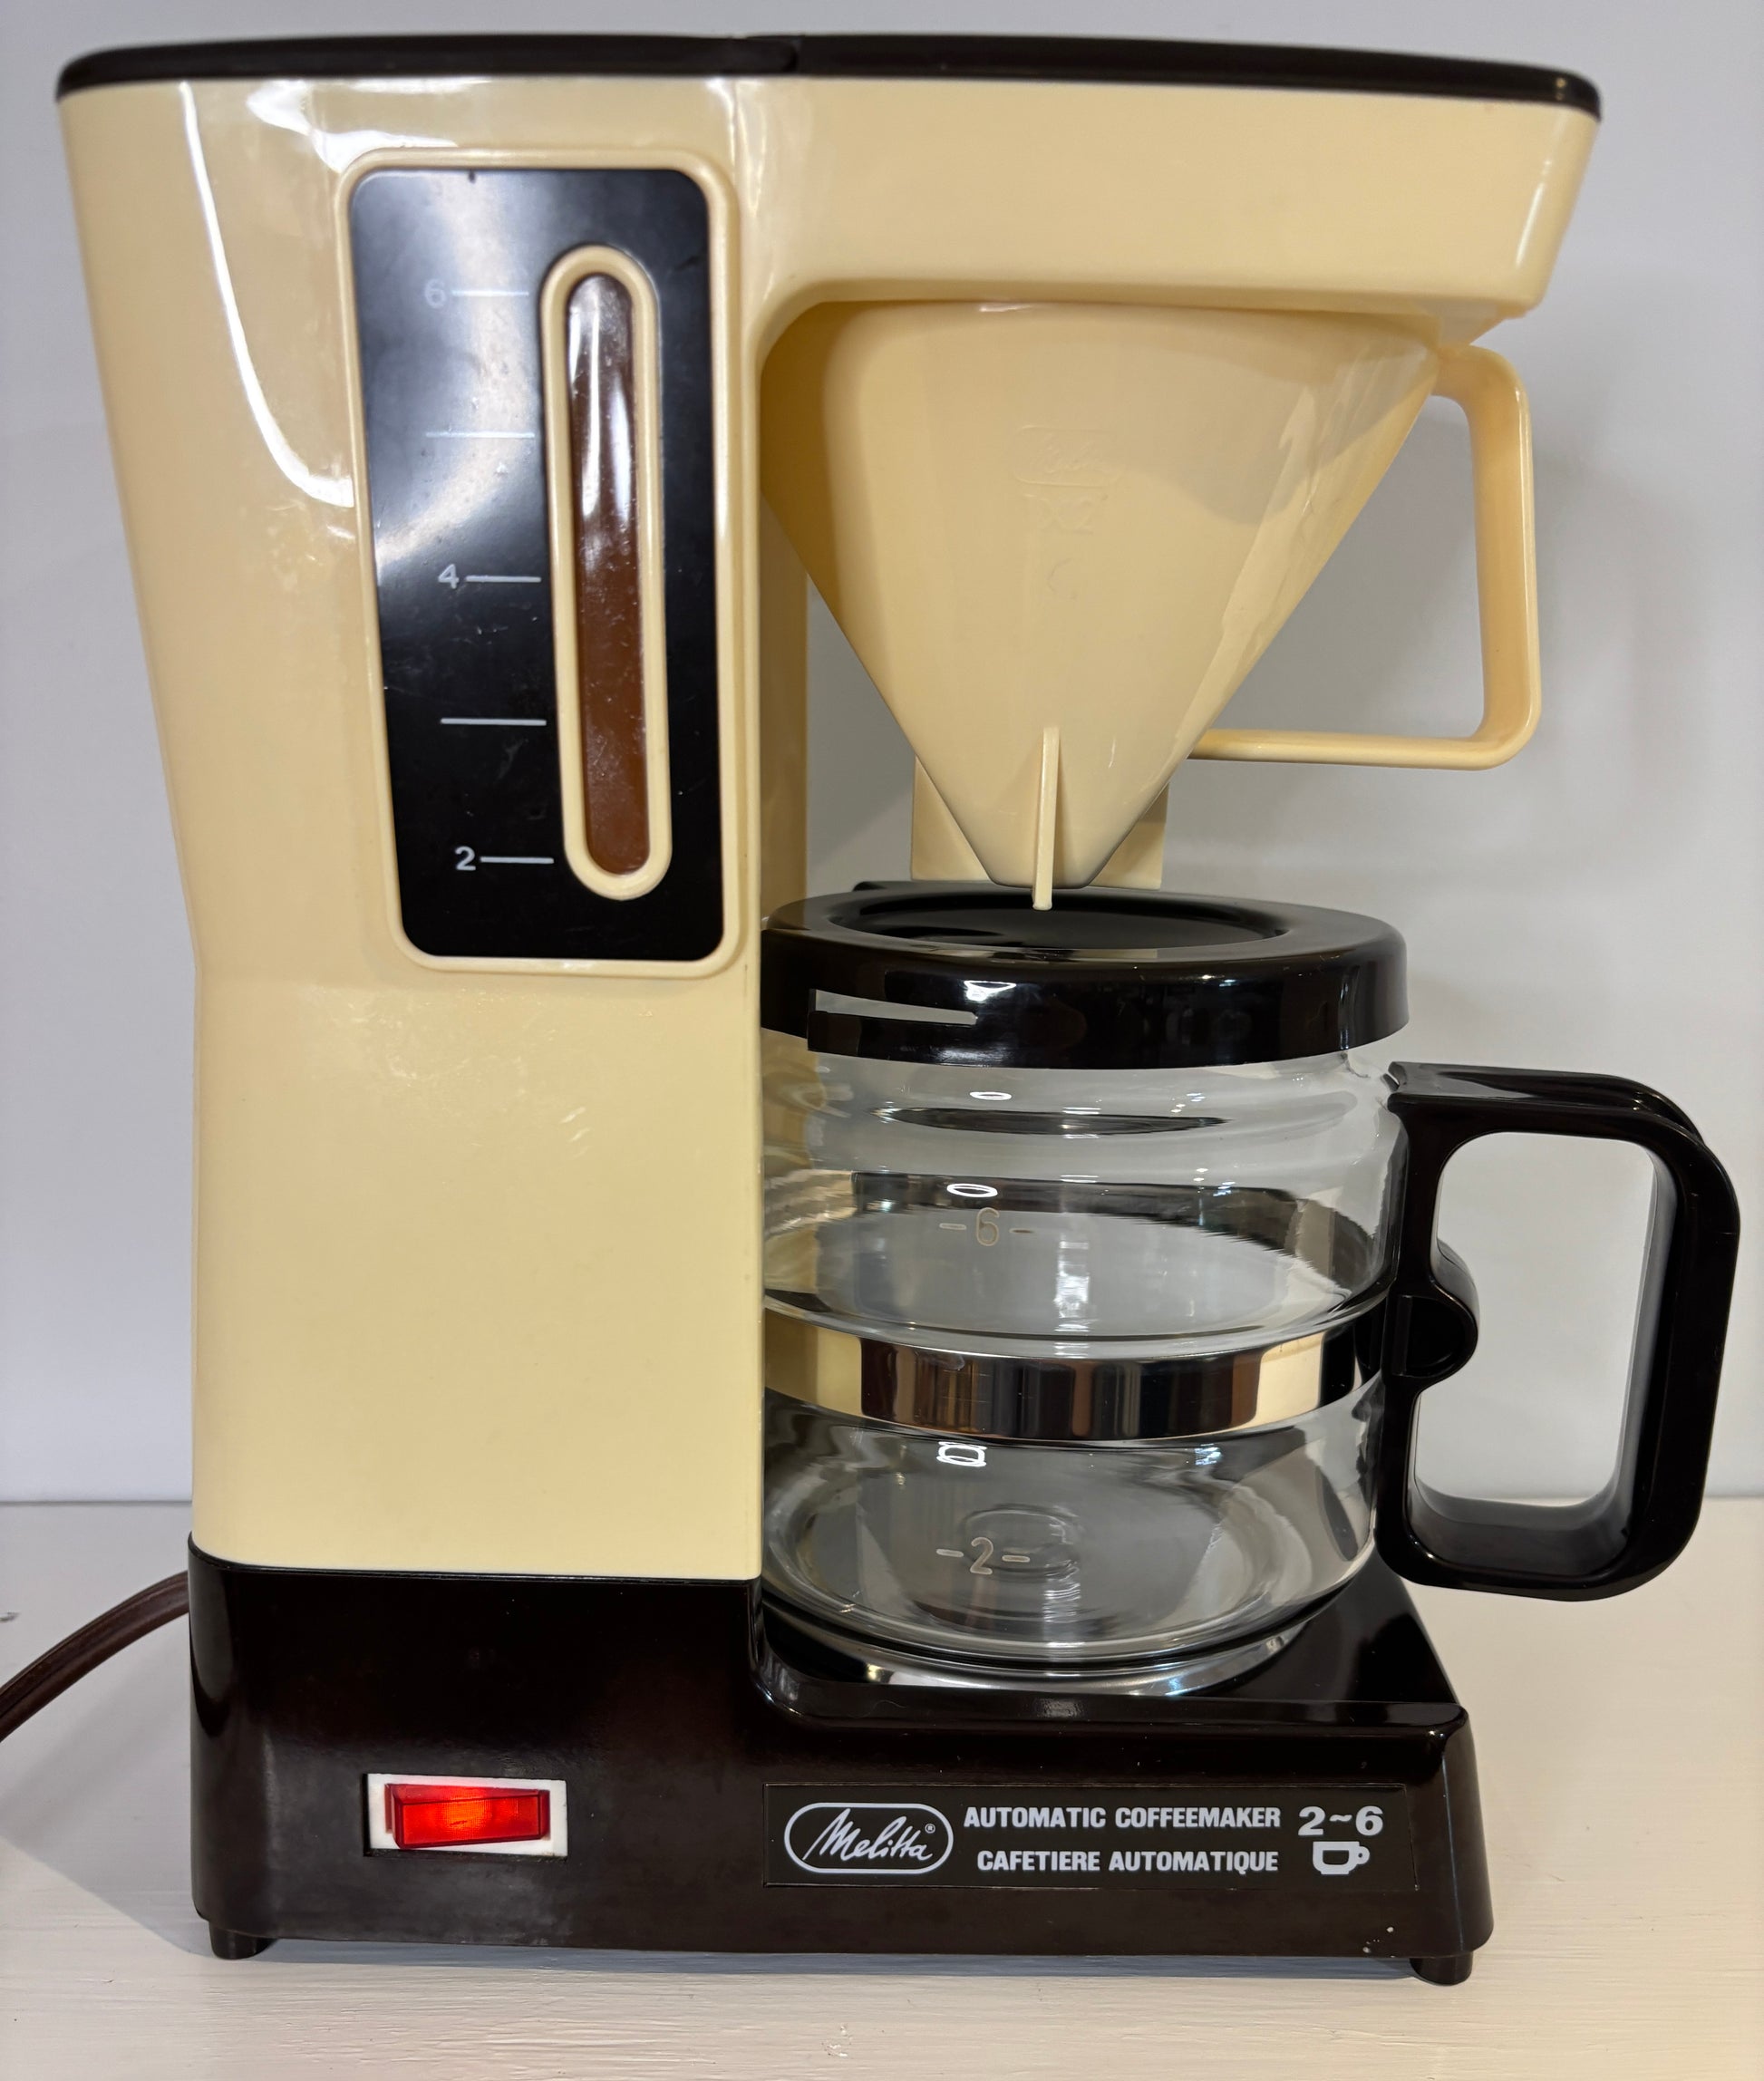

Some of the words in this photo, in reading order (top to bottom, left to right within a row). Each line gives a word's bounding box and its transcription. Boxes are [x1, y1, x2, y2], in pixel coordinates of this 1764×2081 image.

[424, 278, 446, 308] 6
[438, 563, 460, 589] 4
[455, 846, 477, 871] 2
[963, 1806, 1106, 1828] AUTOMATIC
[1115, 1806, 1281, 1828] COFFEEMAKER
[977, 1850, 1100, 1872] CAFETIERE
[1108, 1851, 1279, 1875] AUTOMATIQUE
